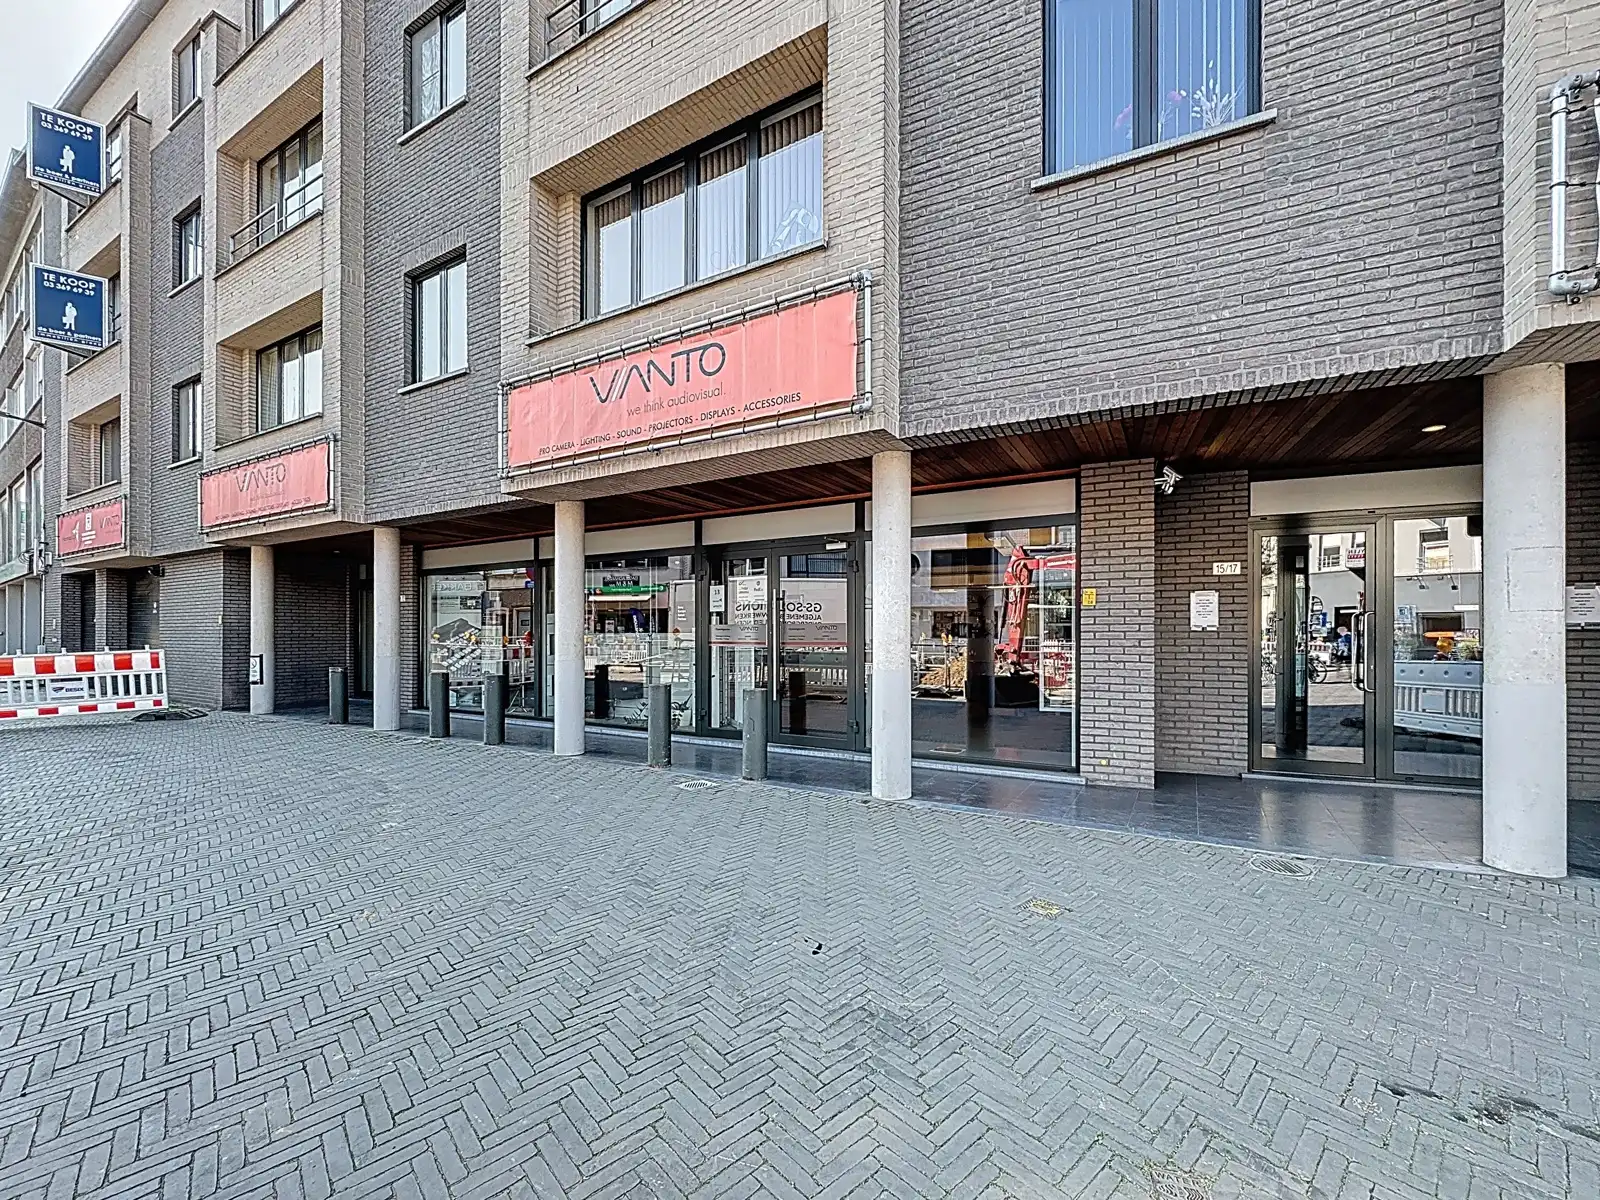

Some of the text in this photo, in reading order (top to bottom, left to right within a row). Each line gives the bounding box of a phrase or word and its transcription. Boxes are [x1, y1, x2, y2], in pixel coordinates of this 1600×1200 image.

[40, 112, 94, 134] TE KOOP
[41, 121, 52, 129] 03
[42, 272, 96, 289] TE KOOP
[589, 342, 727, 404] VANTO
[626, 382, 726, 417] we think audiovisual.
[538, 445, 551, 456] PRO
[551, 442, 575, 453] CAMERA
[580, 433, 611, 447] LIGHTING
[616, 426, 642, 439] SOUND
[648, 416, 693, 432] PROJECTORS
[700, 406, 736, 422] DISPLAYS
[743, 392, 802, 413] ACCESSORIES
[1215, 563, 1238, 574] 15/17
